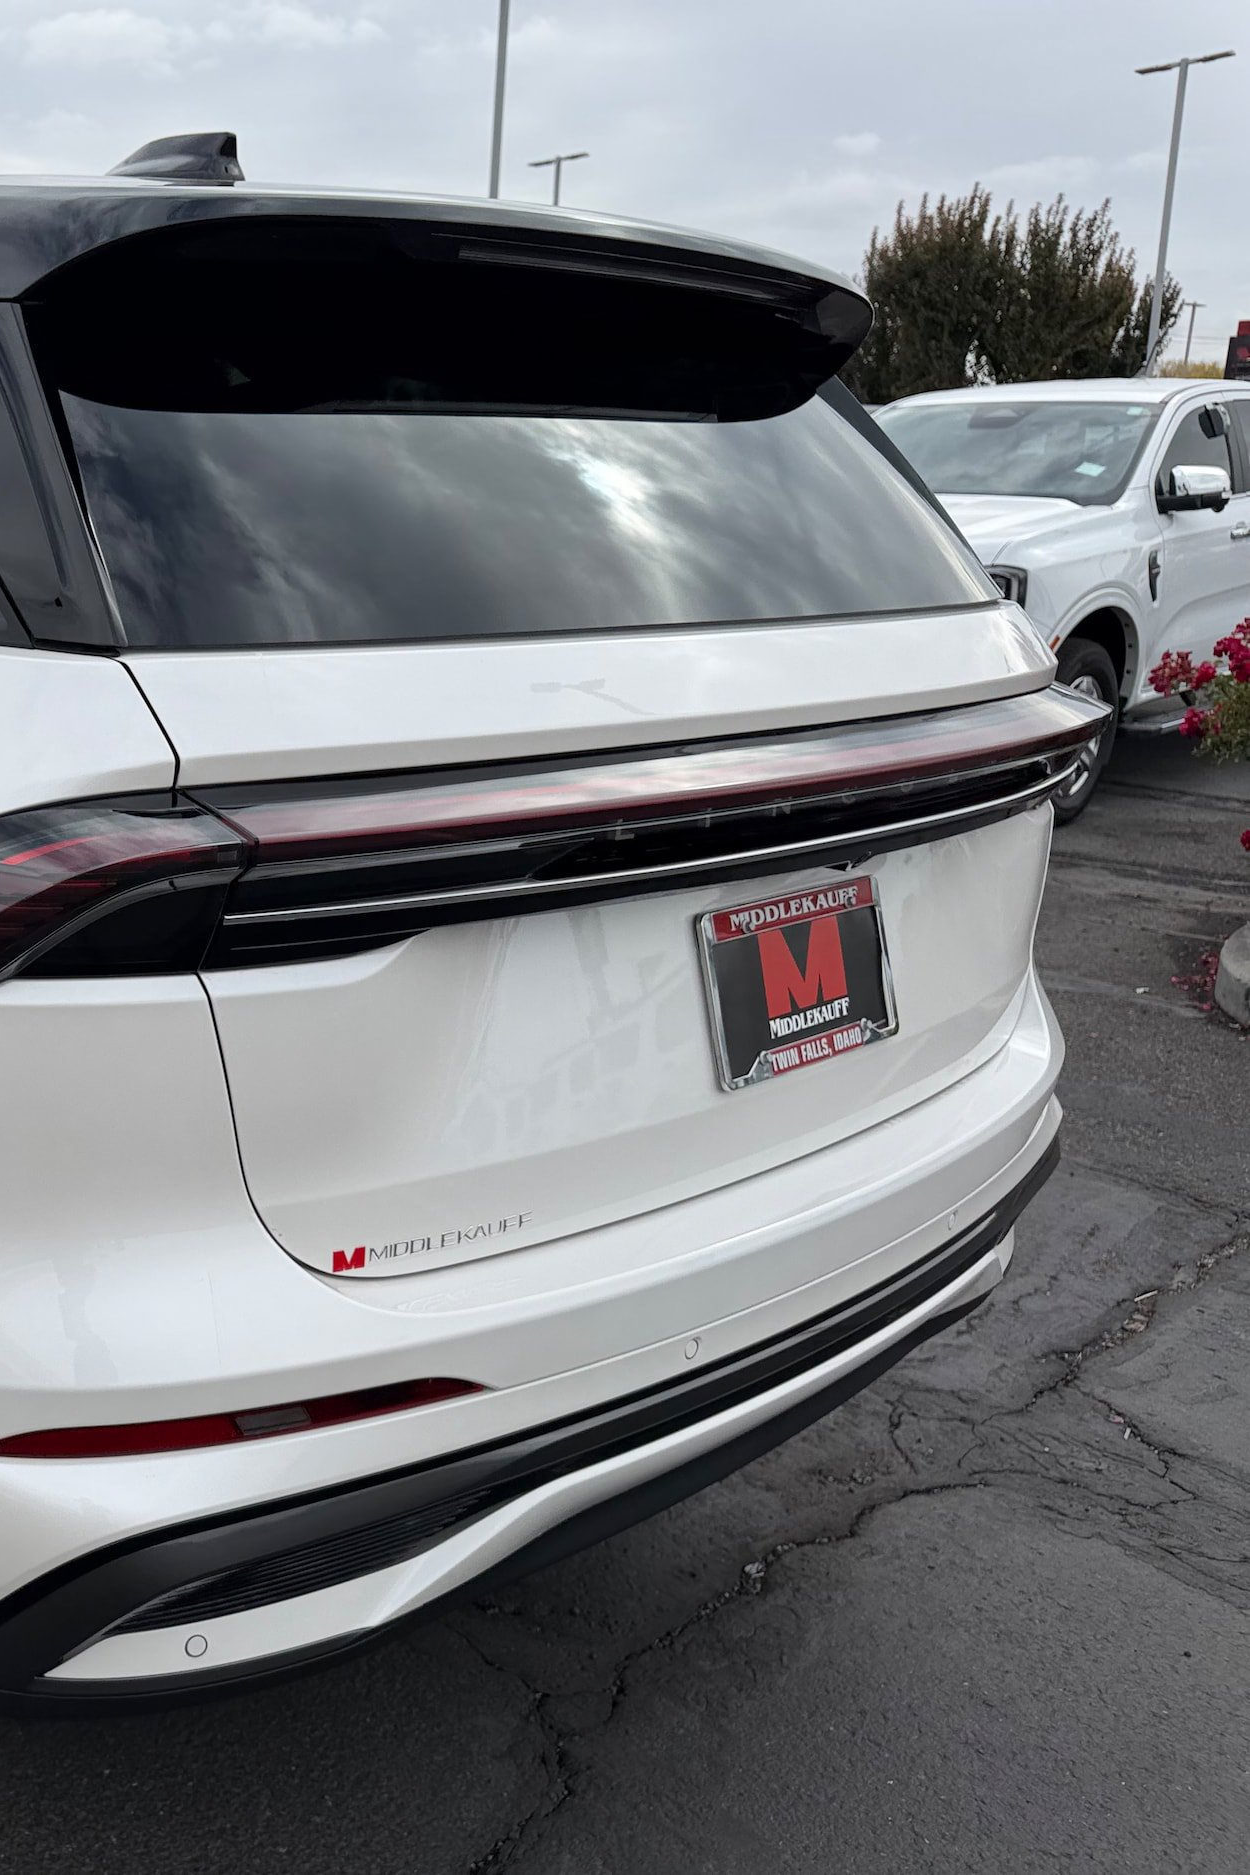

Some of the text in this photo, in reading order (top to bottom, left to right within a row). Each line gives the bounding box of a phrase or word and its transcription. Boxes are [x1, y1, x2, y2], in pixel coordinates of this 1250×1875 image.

[729, 886, 858, 931] MIDDLEKAUFF
[757, 915, 848, 1019] M
[769, 997, 850, 1039] MIDDLEKAUFF
[772, 1026, 862, 1072] TWIN FALLS, IDAHO
[369, 1209, 534, 1262] MIDDLEKAUFF
